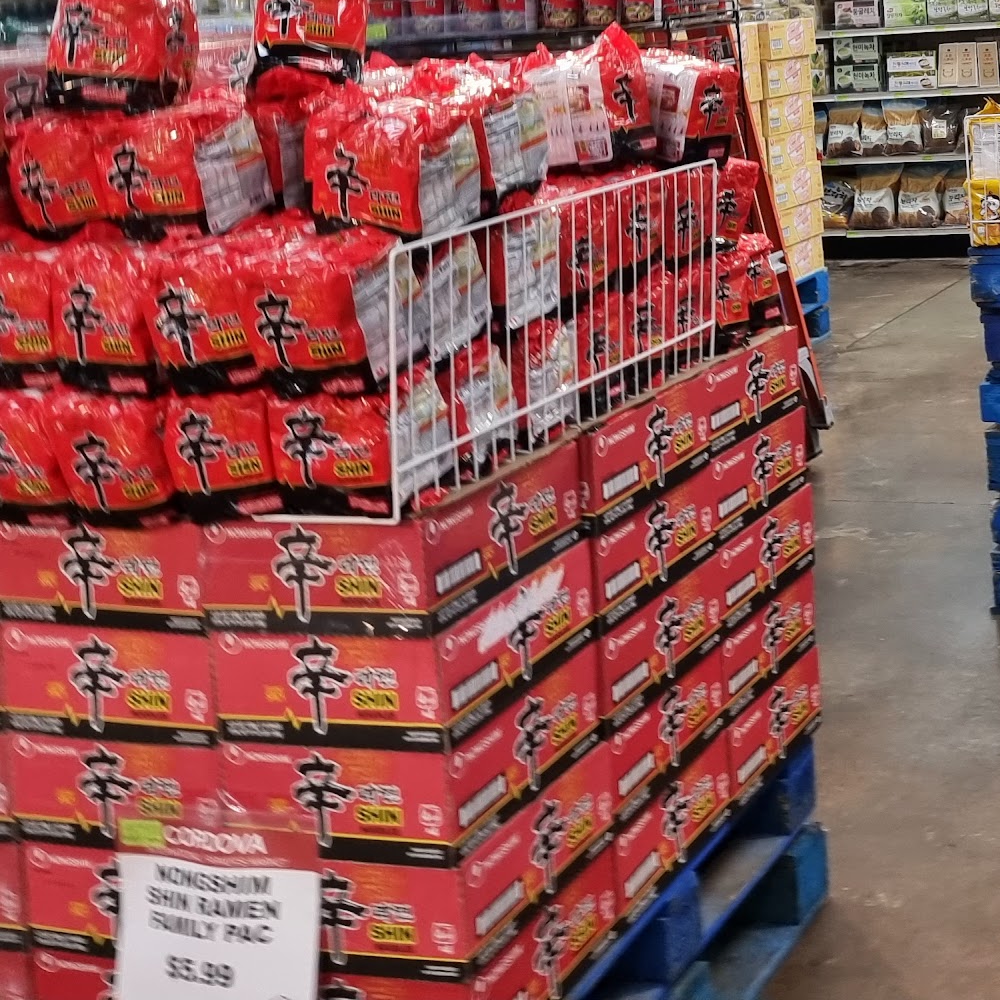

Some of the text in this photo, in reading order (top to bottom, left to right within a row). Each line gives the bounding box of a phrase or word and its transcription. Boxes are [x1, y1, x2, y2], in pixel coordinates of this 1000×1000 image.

[700, 83, 724, 133] 辛
[107, 140, 152, 220] 辛
[325, 139, 371, 223] 辛
[62, 275, 105, 366] 辛
[155, 282, 208, 368] 辛
[254, 289, 307, 373] 辛
[745, 350, 770, 424] 辛
[769, 374, 786, 394] SHIN
[72, 431, 123, 514] 辛
[175, 407, 227, 496] 辛
[280, 405, 341, 490] 辛
[644, 404, 674, 487] 辛
[673, 429, 695, 454] SHIN
[752, 433, 776, 508] 辛
[776, 455, 793, 478] SHIN
[488, 480, 530, 576] 辛
[645, 500, 674, 583] 辛
[675, 520, 697, 547] SHIN
[759, 516, 784, 590] 辛
[59, 523, 120, 621] 辛
[119, 577, 163, 600] SHIN
[271, 523, 337, 624] 辛
[336, 576, 380, 597] SHIN
[655, 596, 685, 679] 辛
[68, 634, 131, 734] 辛
[128, 689, 171, 711] SHIN
[287, 635, 353, 736] 辛
[353, 690, 397, 709] SHIN
[513, 695, 551, 790] 辛
[77, 743, 140, 839] 辛
[290, 750, 357, 848] 辛
[357, 805, 401, 825] SHIN
[146, 885, 191, 911] SHIN
[154, 863, 272, 895] NONGSHIM
[371, 925, 414, 943] SHIN
